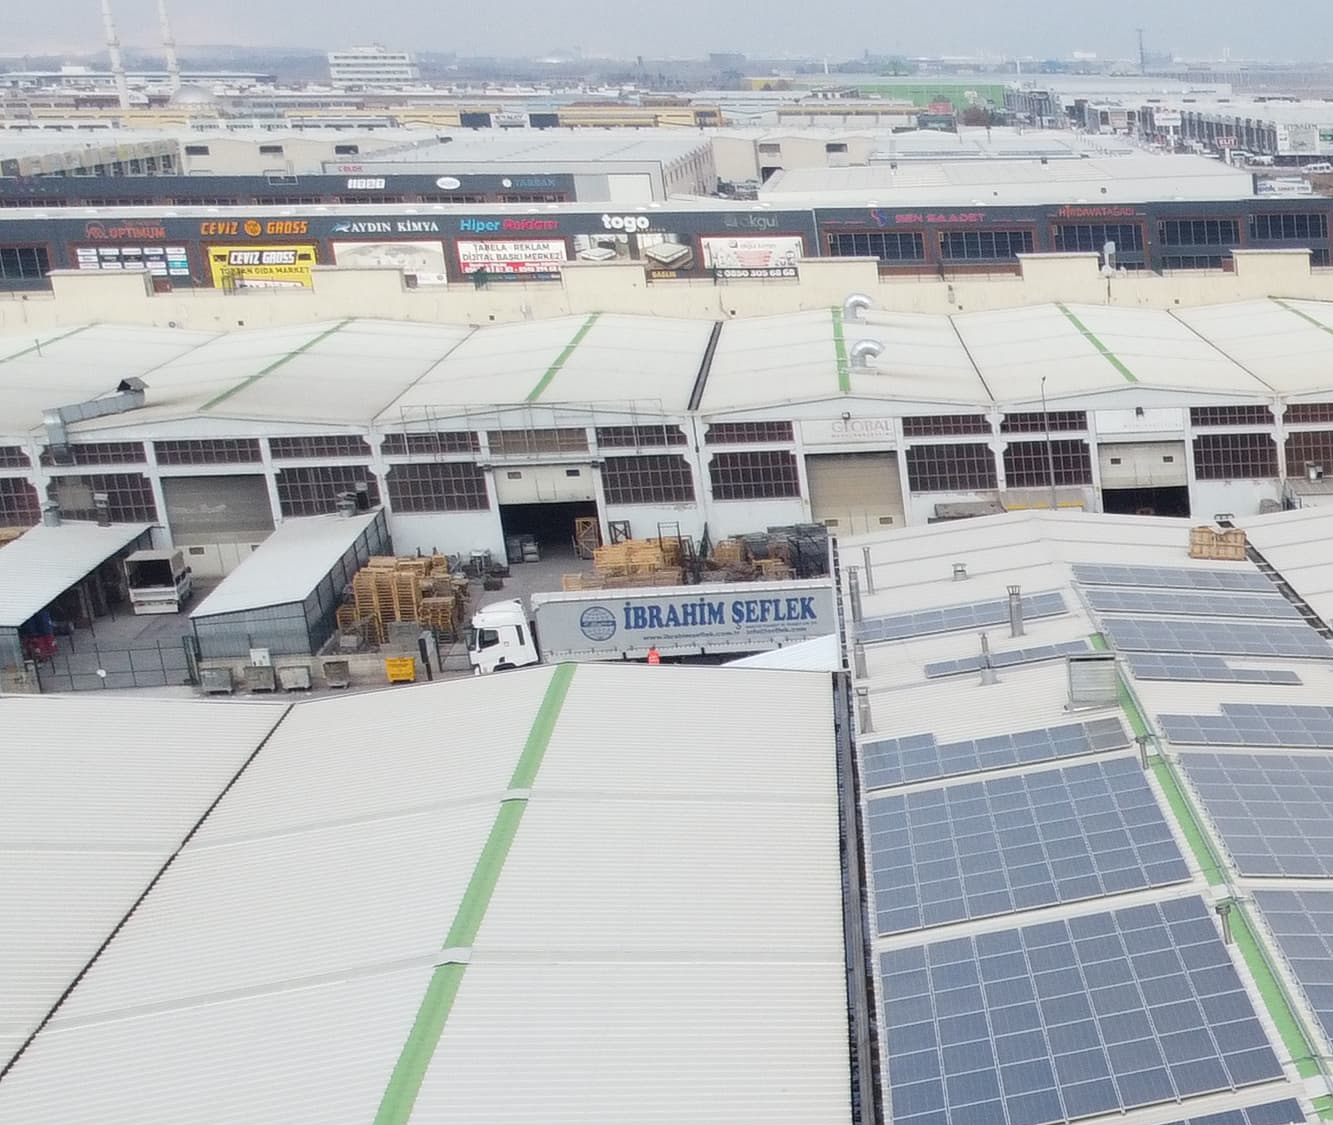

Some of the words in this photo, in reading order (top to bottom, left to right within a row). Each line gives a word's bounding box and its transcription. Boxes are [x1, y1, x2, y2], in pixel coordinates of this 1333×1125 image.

[266, 220, 309, 235] GROSS
[350, 221, 392, 233] AYDIN
[397, 219, 440, 232] KİMYA
[460, 218, 500, 233] Hiper
[601, 213, 650, 233] togo
[514, 243, 550, 252] REKLAM
[261, 250, 296, 265] GROSS
[275, 266, 310, 274] MARKET
[624, 597, 726, 630] İBRAHİM
[731, 596, 818, 629] ŞEFLEK
